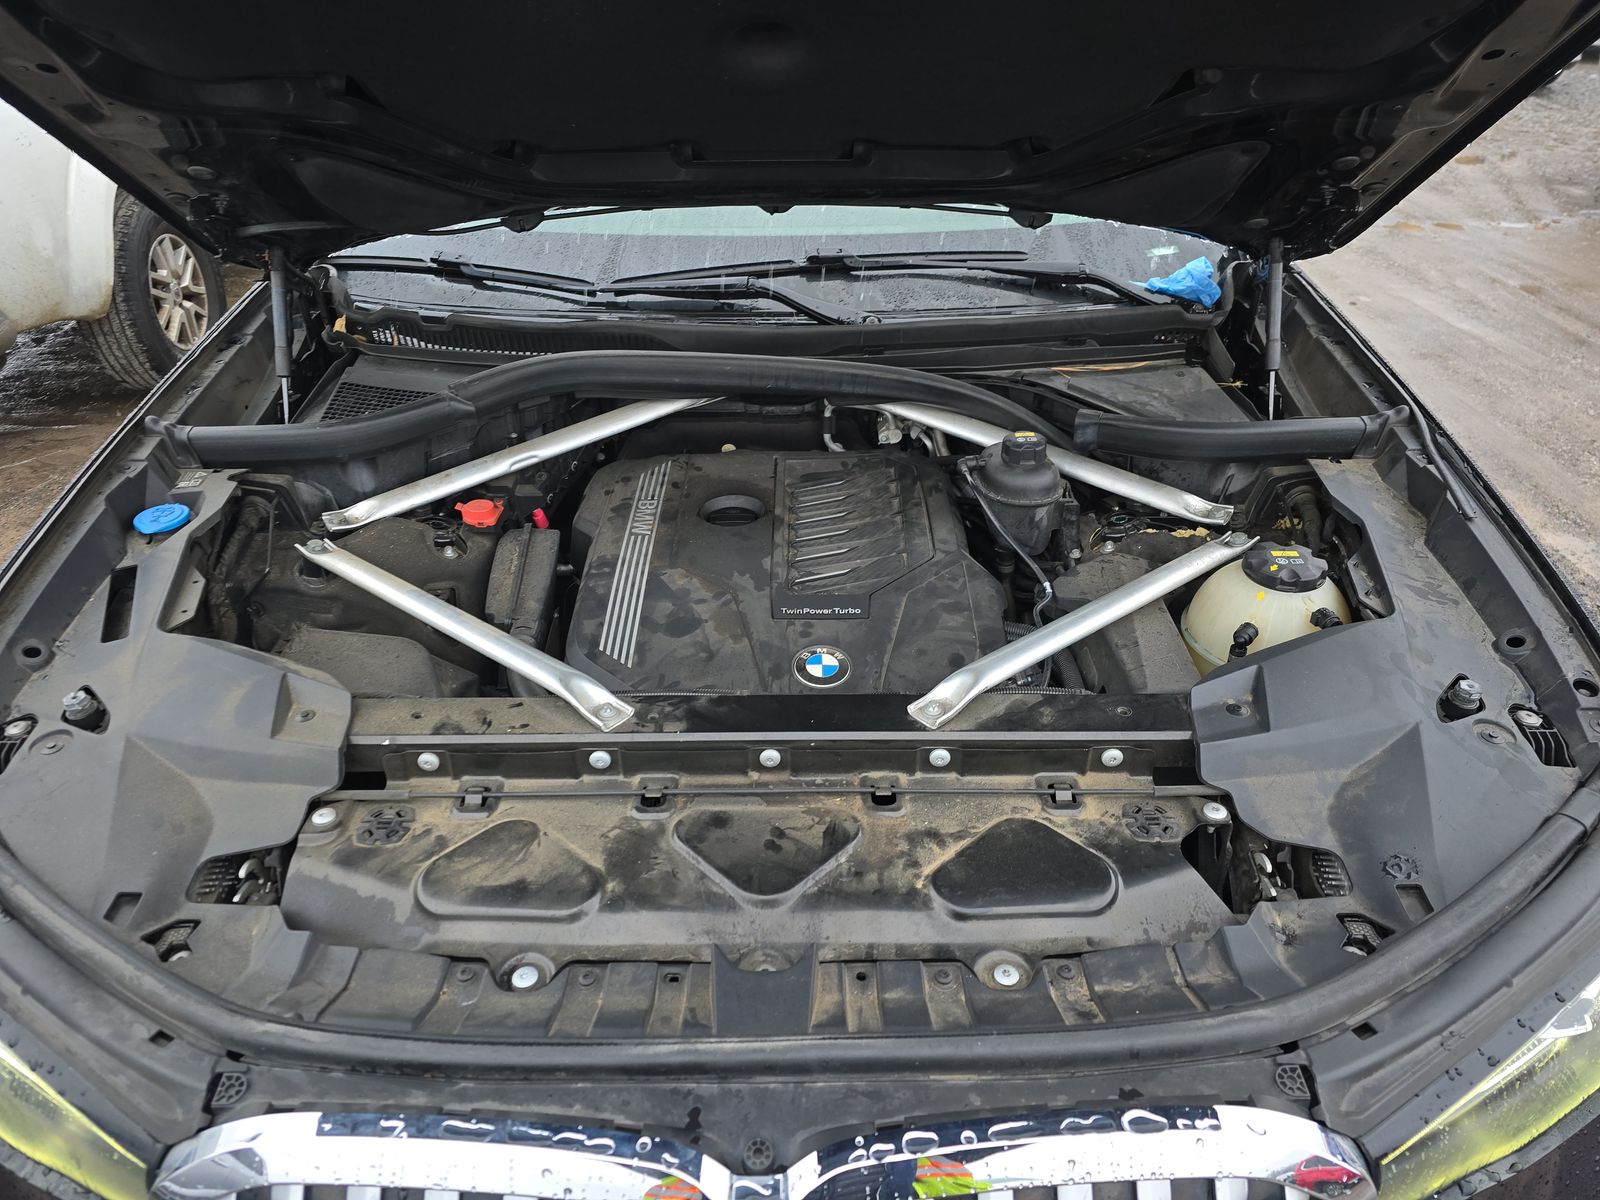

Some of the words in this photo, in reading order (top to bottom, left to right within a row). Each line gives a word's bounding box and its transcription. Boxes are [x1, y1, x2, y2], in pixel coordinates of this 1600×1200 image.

[632, 500, 657, 535] BMW
[833, 607, 861, 615] Turbo
[800, 647, 846, 660] BMW
